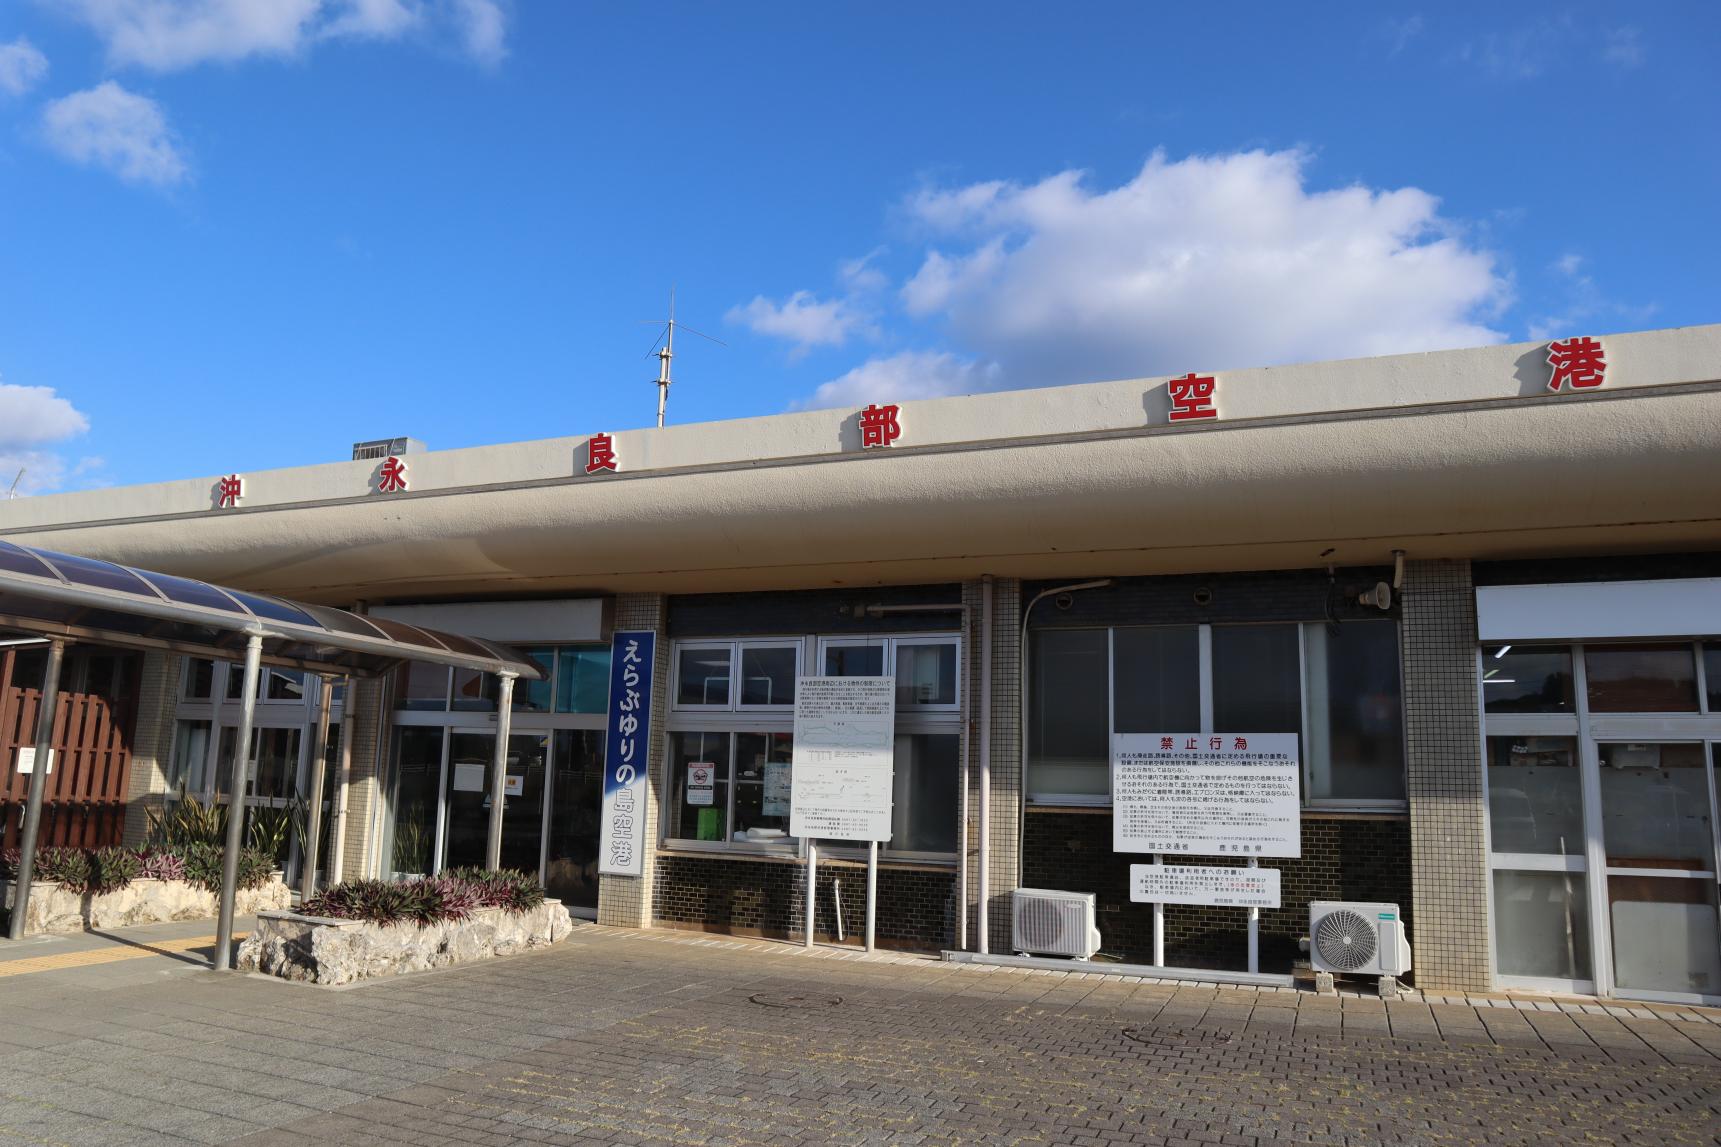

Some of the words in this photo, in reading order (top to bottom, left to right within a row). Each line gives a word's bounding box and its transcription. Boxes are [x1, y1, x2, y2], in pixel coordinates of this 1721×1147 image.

[1161, 737, 1248, 750] 禁止行為
[609, 639, 642, 867] えらぶゆりの島空港
[1148, 842, 1188, 850] 国土交通省
